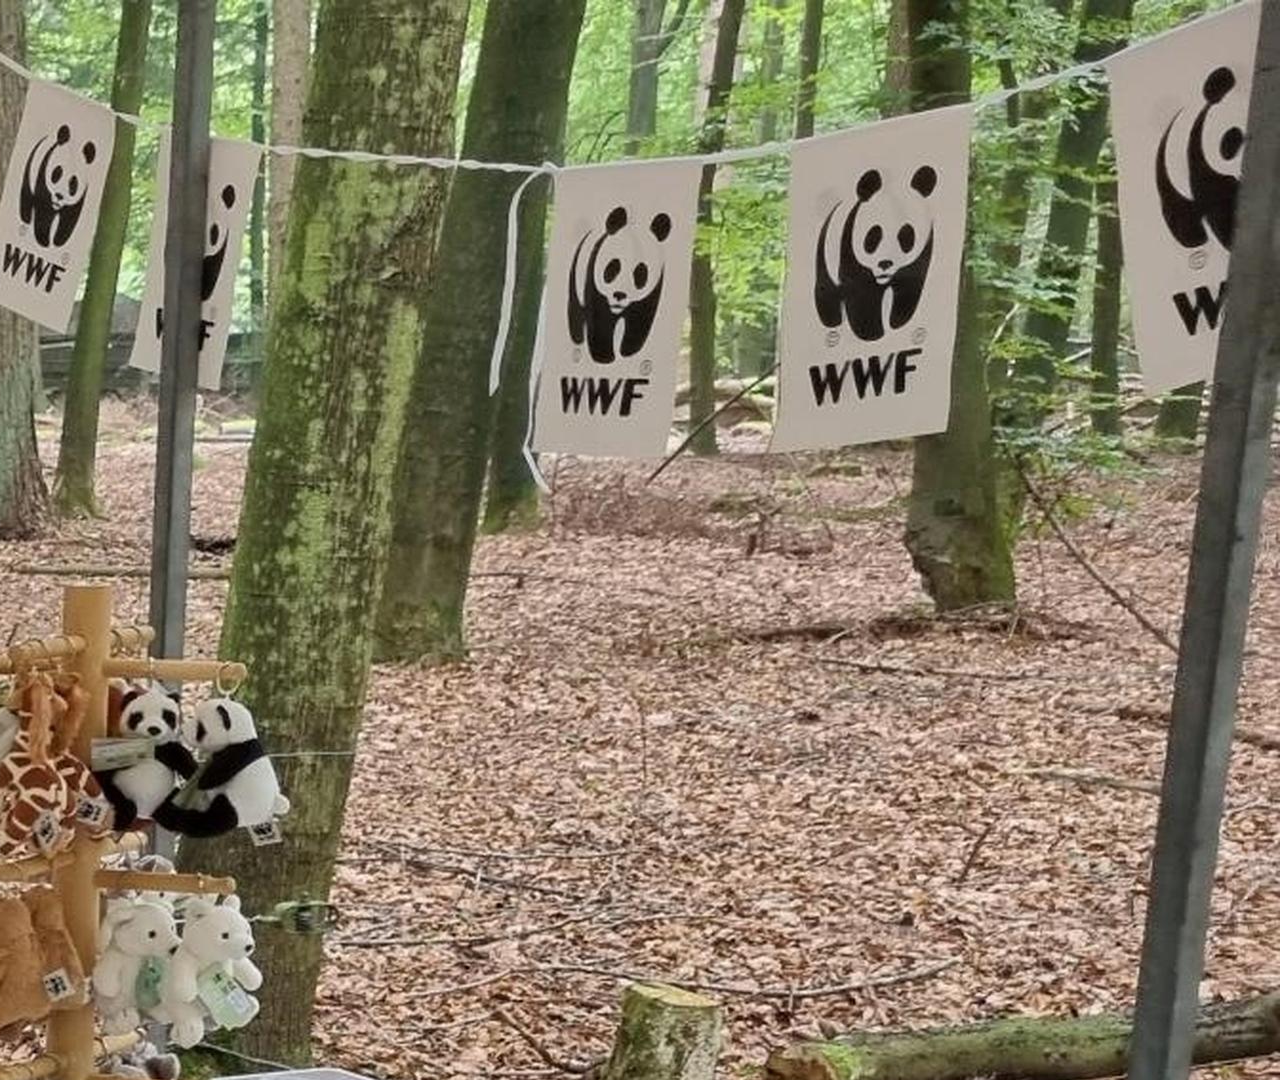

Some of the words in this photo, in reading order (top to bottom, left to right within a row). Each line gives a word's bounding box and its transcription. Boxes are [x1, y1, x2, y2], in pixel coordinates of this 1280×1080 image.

[2, 243, 67, 294] WWF
[560, 376, 650, 417] WWF
[808, 347, 923, 407] WWF
